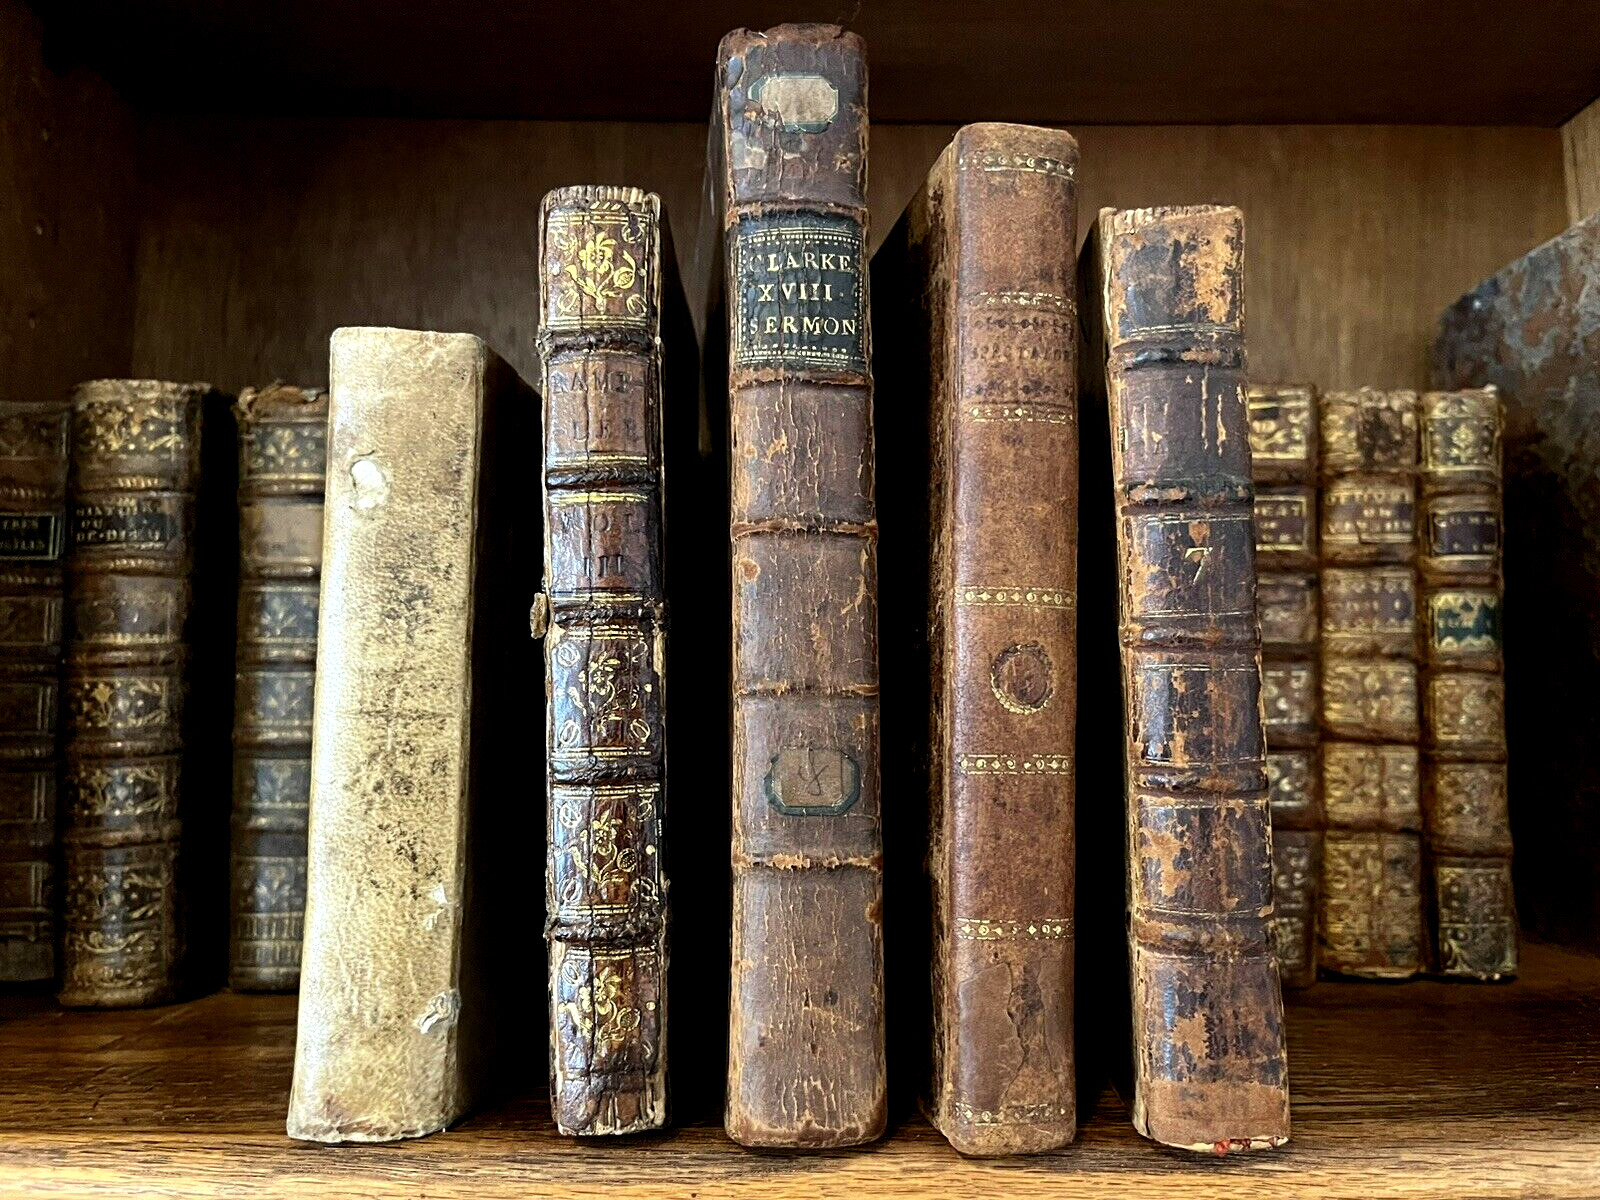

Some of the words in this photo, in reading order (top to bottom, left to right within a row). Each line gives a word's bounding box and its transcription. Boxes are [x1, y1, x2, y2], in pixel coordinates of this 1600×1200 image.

[749, 252, 855, 273] CLARKE
[749, 316, 857, 335] SERMON
[1184, 546, 1214, 586] 7
